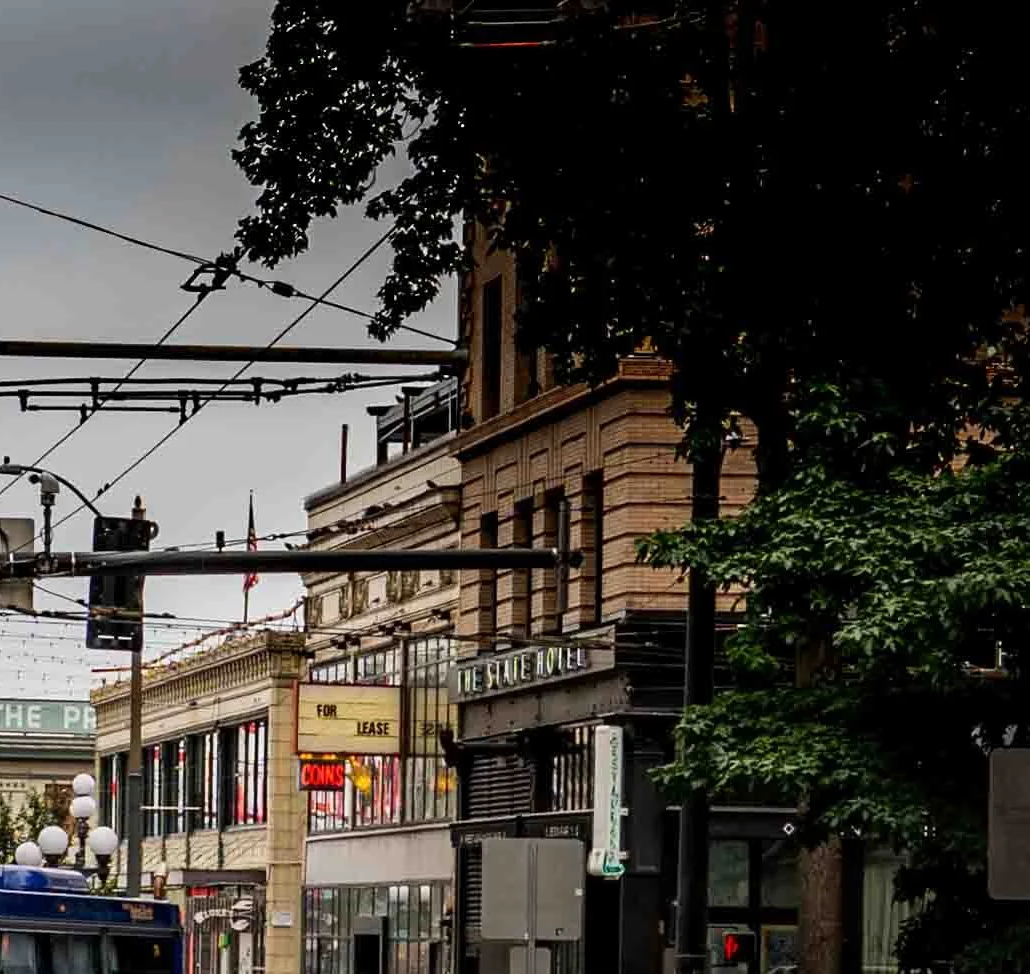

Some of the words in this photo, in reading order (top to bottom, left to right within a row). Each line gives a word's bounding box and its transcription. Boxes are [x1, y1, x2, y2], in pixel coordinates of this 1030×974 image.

[458, 665, 483, 692] THE
[487, 651, 532, 689] STATE
[537, 647, 587, 677] HOTEL
[316, 704, 338, 719] FOR
[356, 721, 390, 736] LEASE
